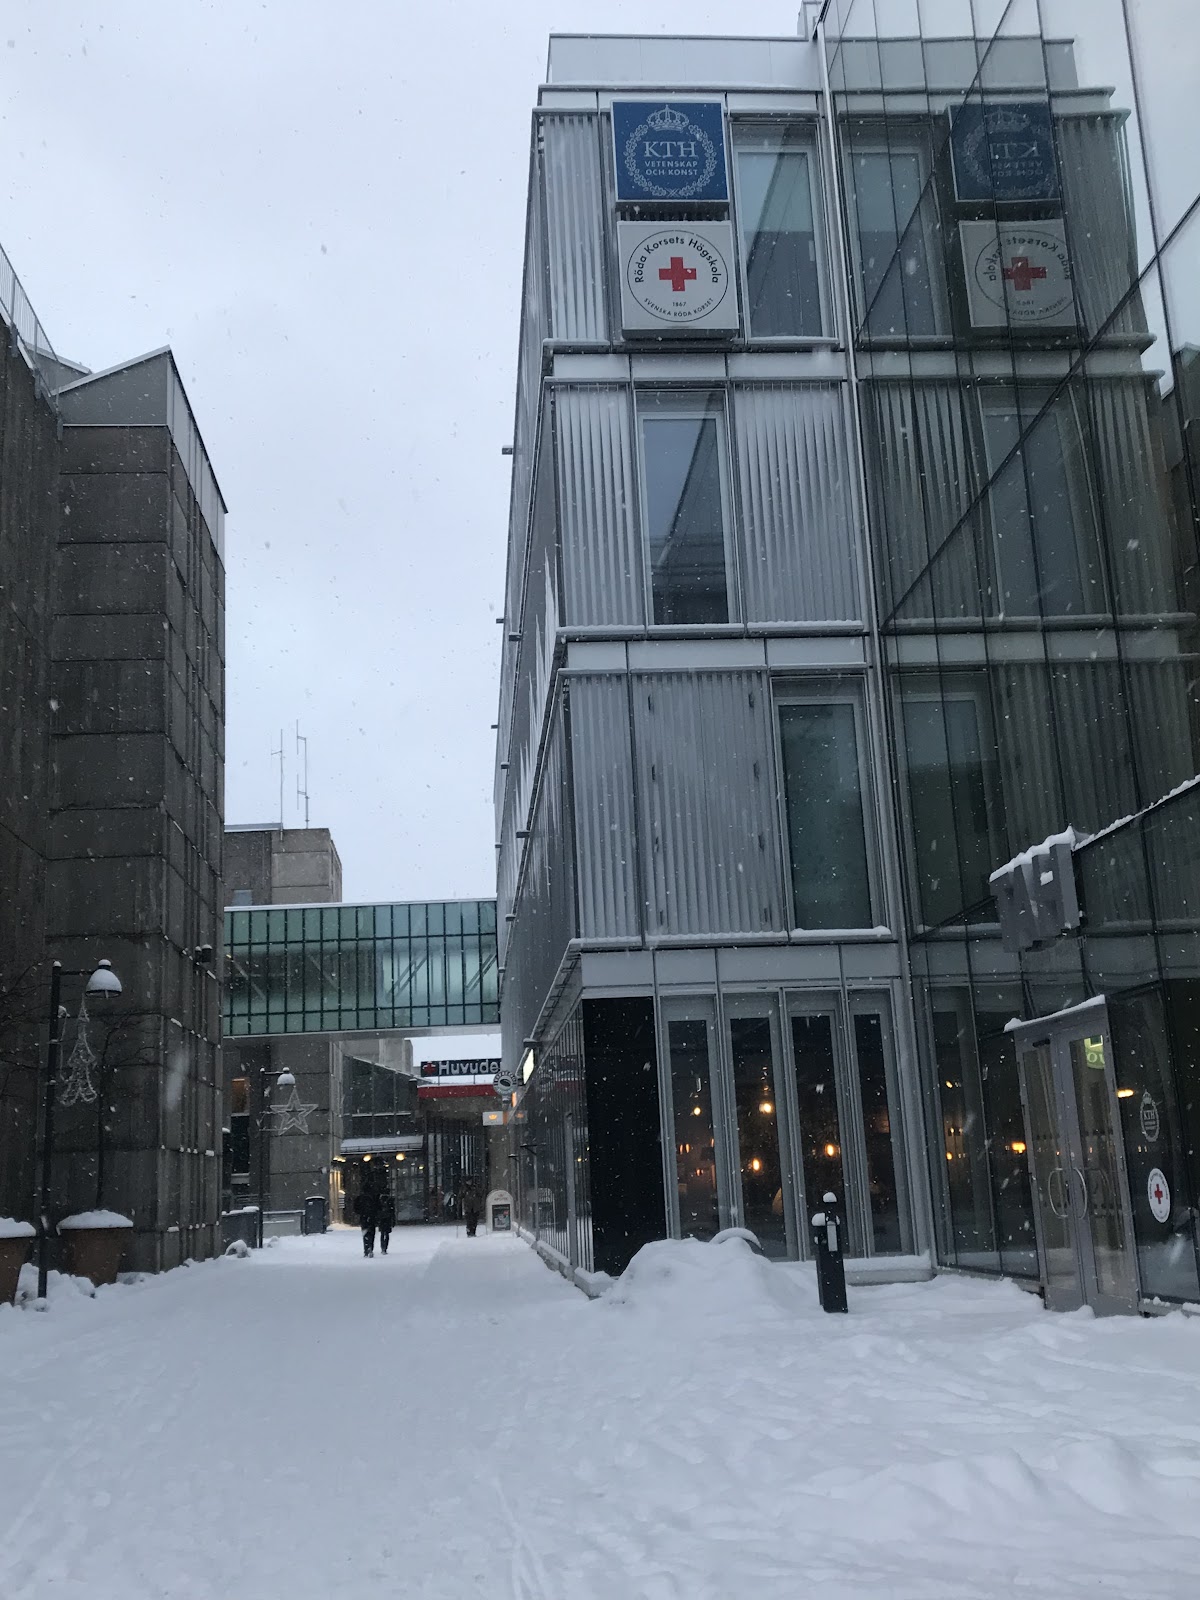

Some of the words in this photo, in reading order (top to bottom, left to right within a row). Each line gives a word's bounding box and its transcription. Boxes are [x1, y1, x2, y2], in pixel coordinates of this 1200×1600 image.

[643, 141, 699, 158] KTH
[645, 160, 698, 168] VETENSKAP
[634, 255, 647, 283] Röda
[644, 236, 685, 254] Korsets
[688, 238, 722, 283] Högskola
[643, 298, 672, 316] SVENSKA
[693, 298, 714, 314] KORSET
[439, 1059, 501, 1075] Huvude
